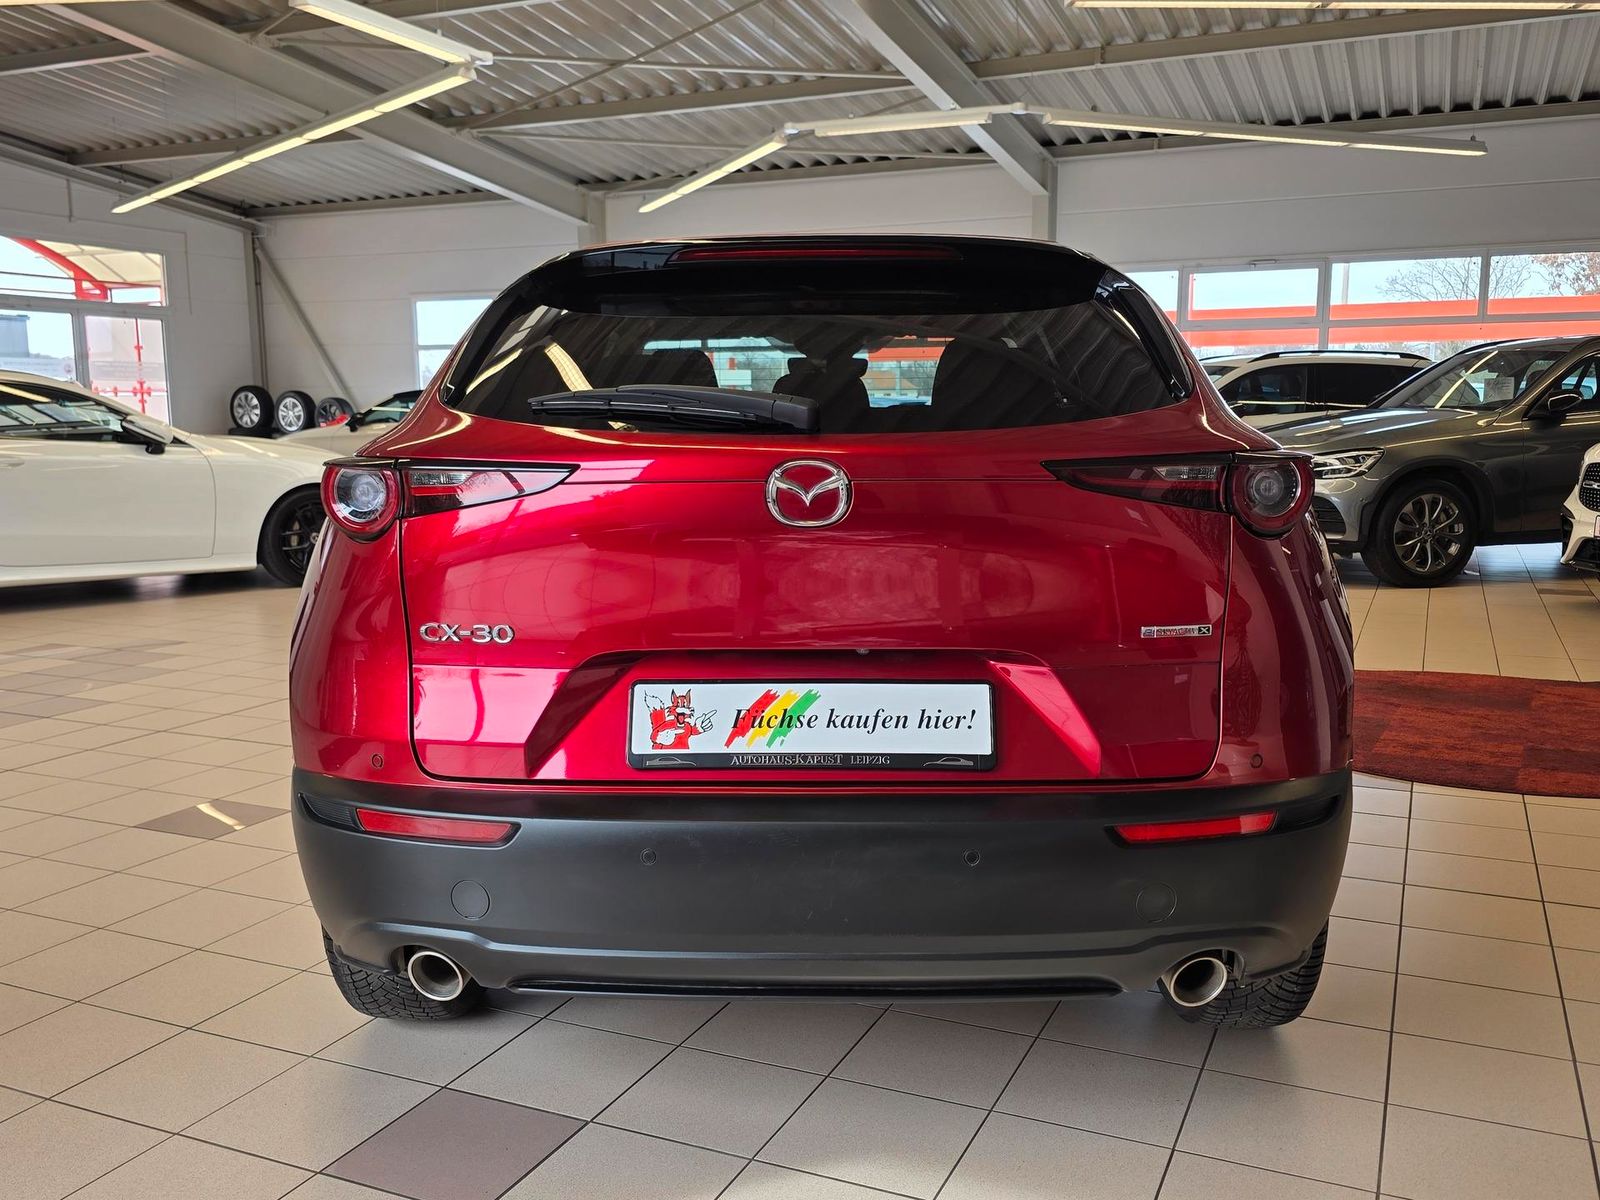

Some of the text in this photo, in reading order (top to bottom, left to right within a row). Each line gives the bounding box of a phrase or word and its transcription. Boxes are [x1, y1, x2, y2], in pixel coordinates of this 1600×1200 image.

[419, 622, 514, 643] CX-30
[731, 708, 977, 734] Füchse kaufen hier!
[850, 755, 890, 765] LEIPZIG
